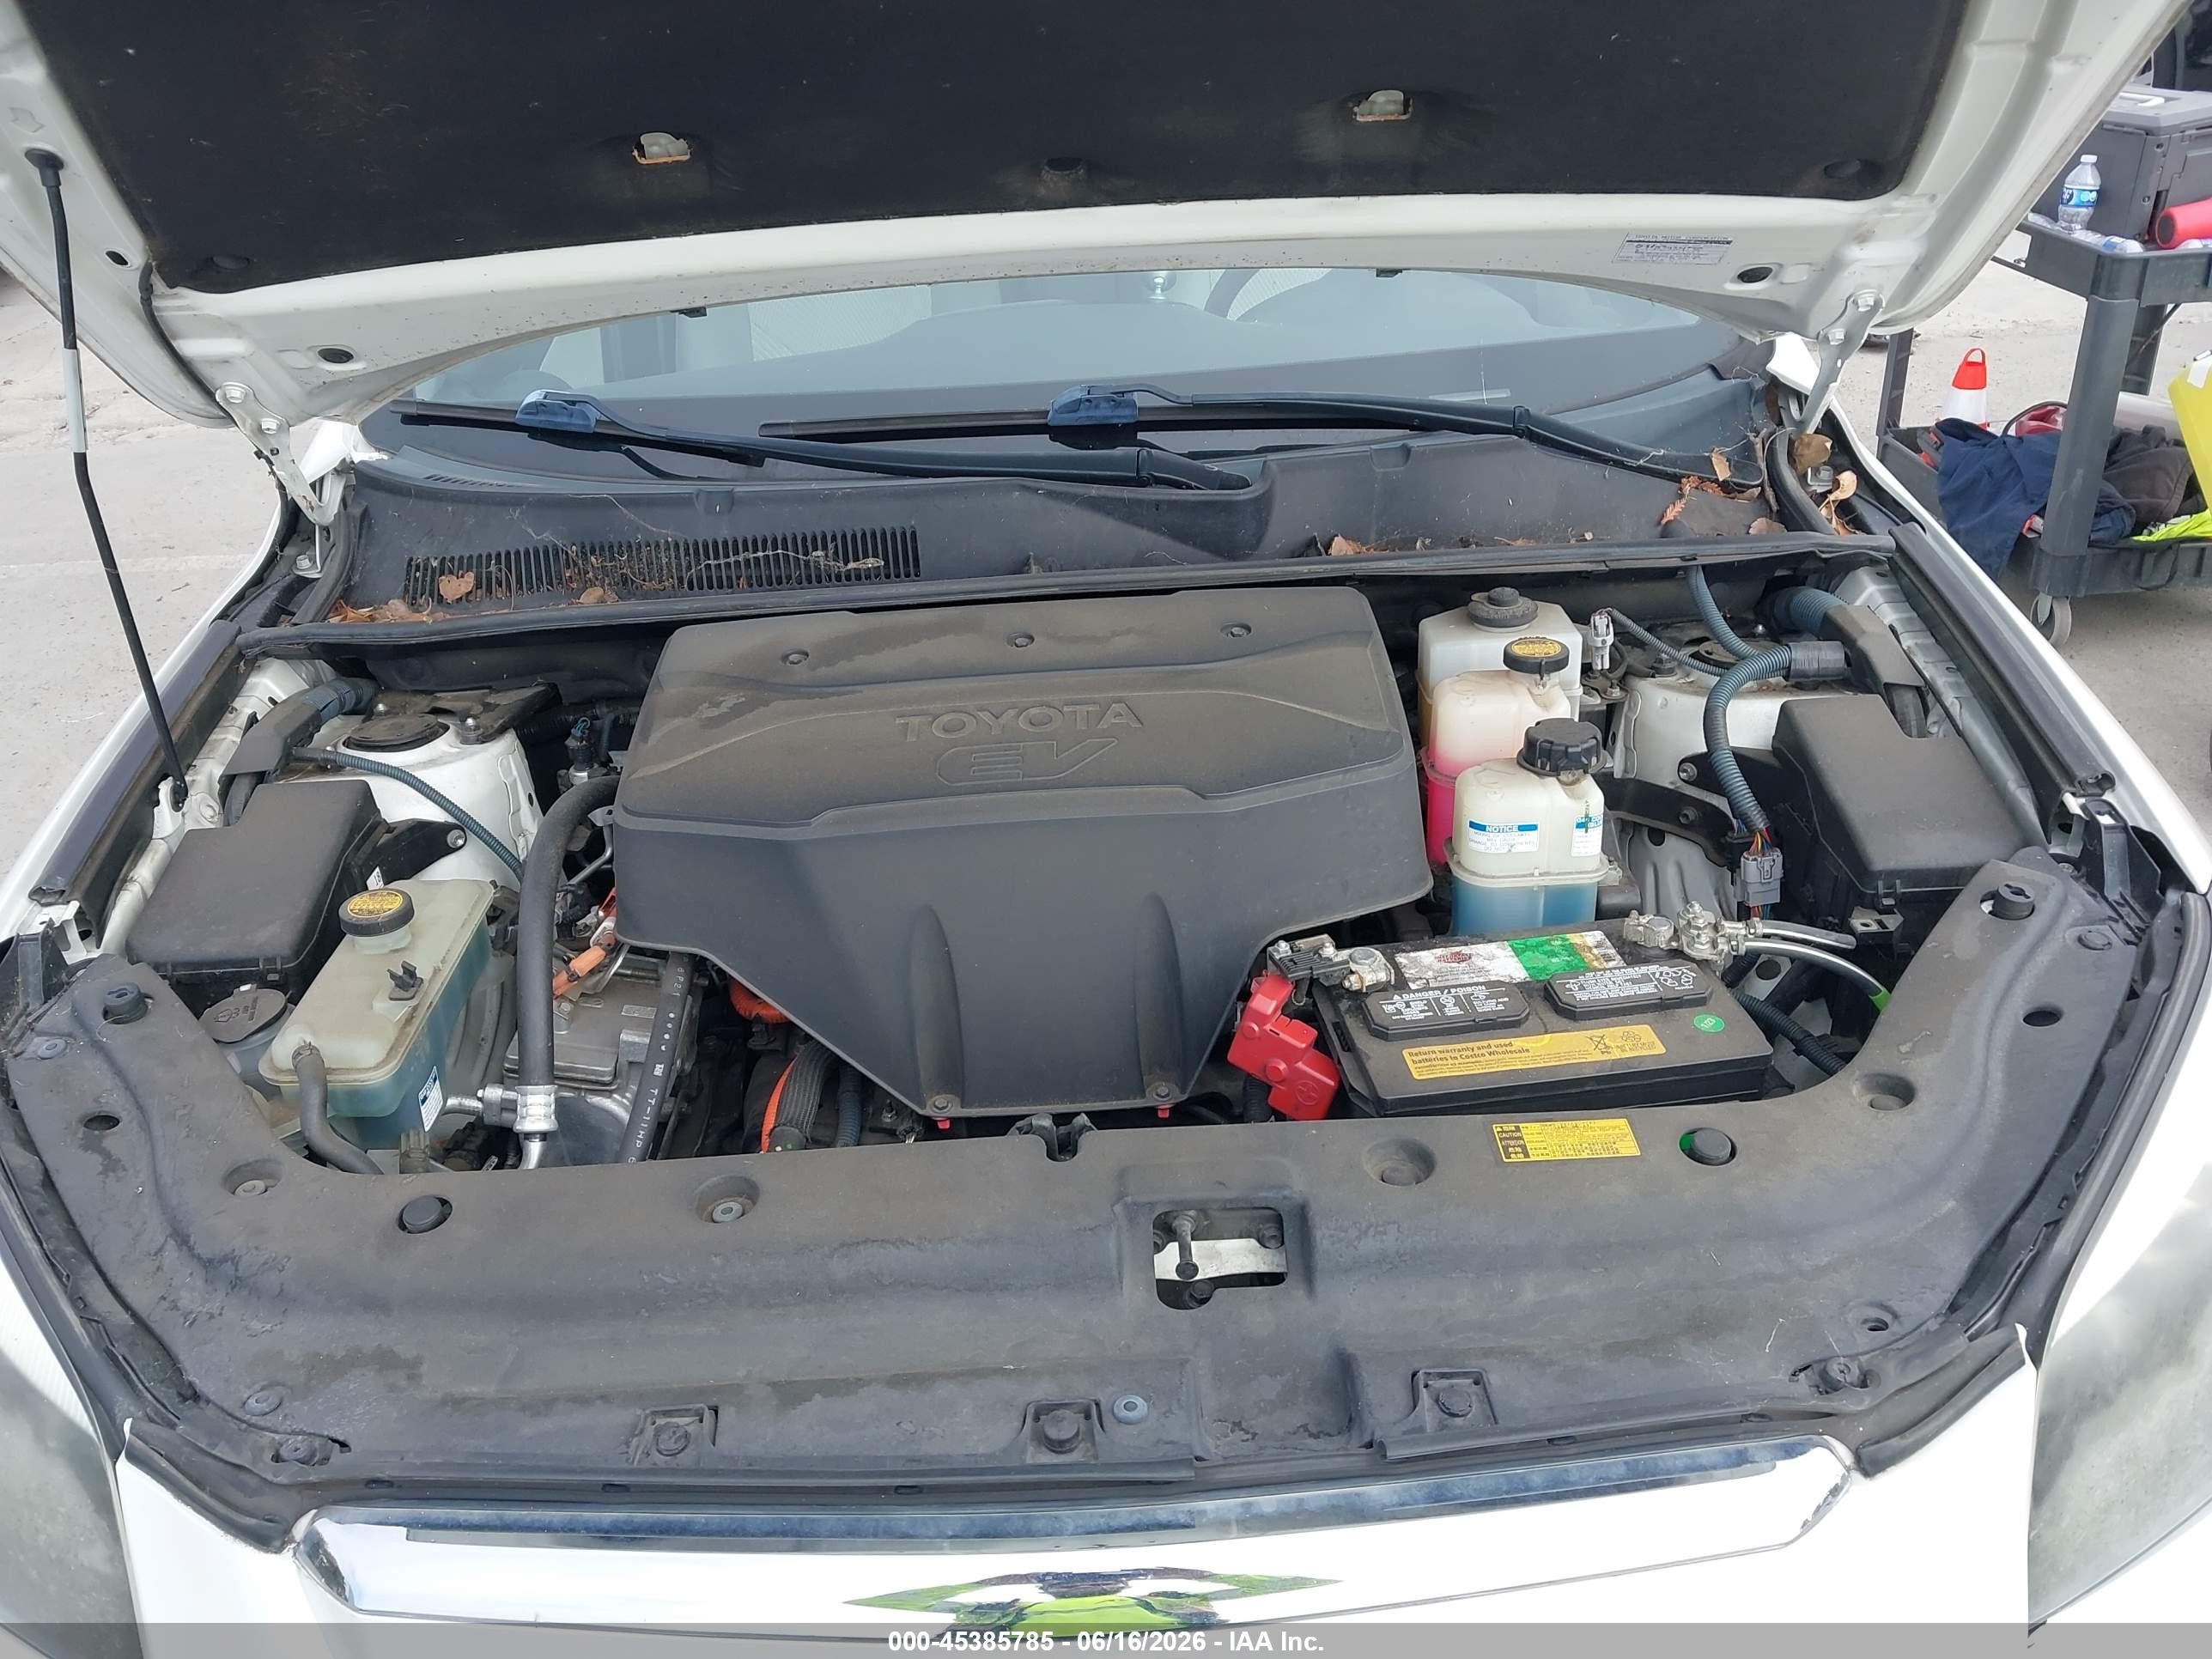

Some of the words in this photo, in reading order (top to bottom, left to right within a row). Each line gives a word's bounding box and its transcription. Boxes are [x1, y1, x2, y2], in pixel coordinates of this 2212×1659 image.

[895, 702, 1143, 742] TOYOTA
[936, 738, 1118, 787] EV
[1486, 824, 1519, 833] NOTICE
[1402, 989, 1442, 1000] DANGER
[1450, 985, 1486, 994] POISON
[1408, 1048, 1437, 1058] Return
[1438, 1045, 1474, 1055] warranty
[1477, 1042, 1492, 1051] and
[1412, 1054, 1449, 1065] batteries
[1460, 1052, 1486, 1060] Costco
[1487, 1047, 1530, 1057] Wholesale
